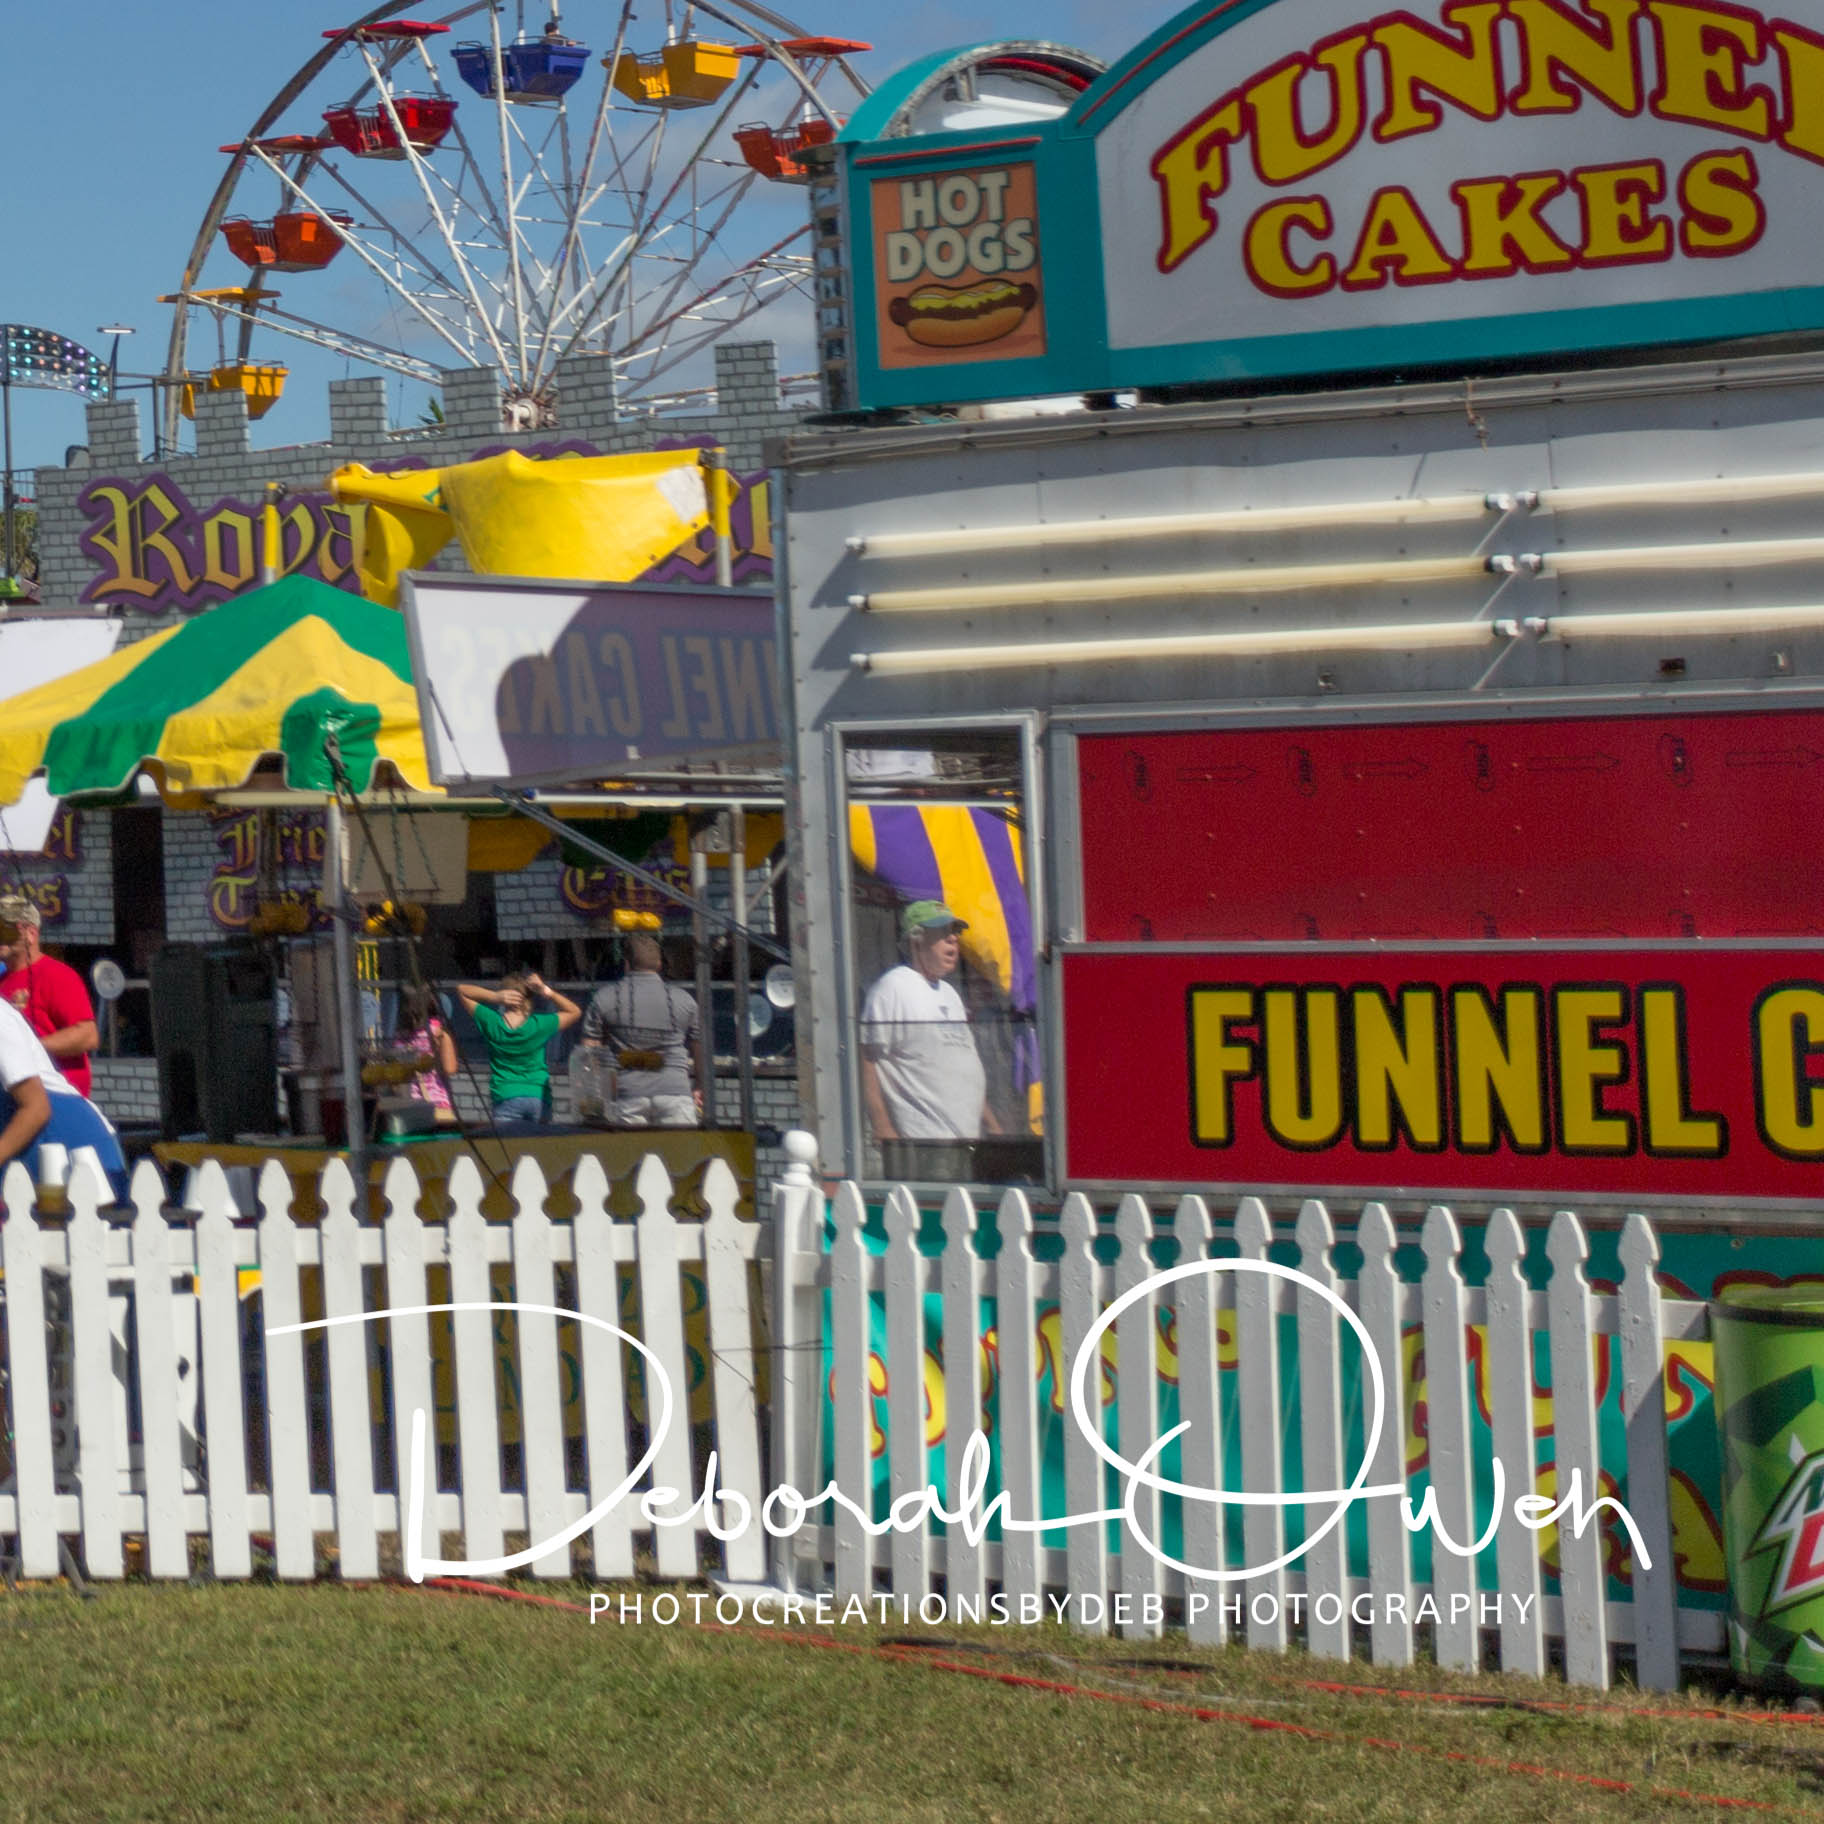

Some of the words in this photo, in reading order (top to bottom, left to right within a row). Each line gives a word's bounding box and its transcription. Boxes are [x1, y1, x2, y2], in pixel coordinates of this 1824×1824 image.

[886, 217, 1036, 282] DOGS
[901, 170, 1009, 230] HOT
[1241, 146, 1767, 299] CAKES
[88, 482, 370, 594] Roya
[1186, 981, 1730, 1161] FUNNEL
